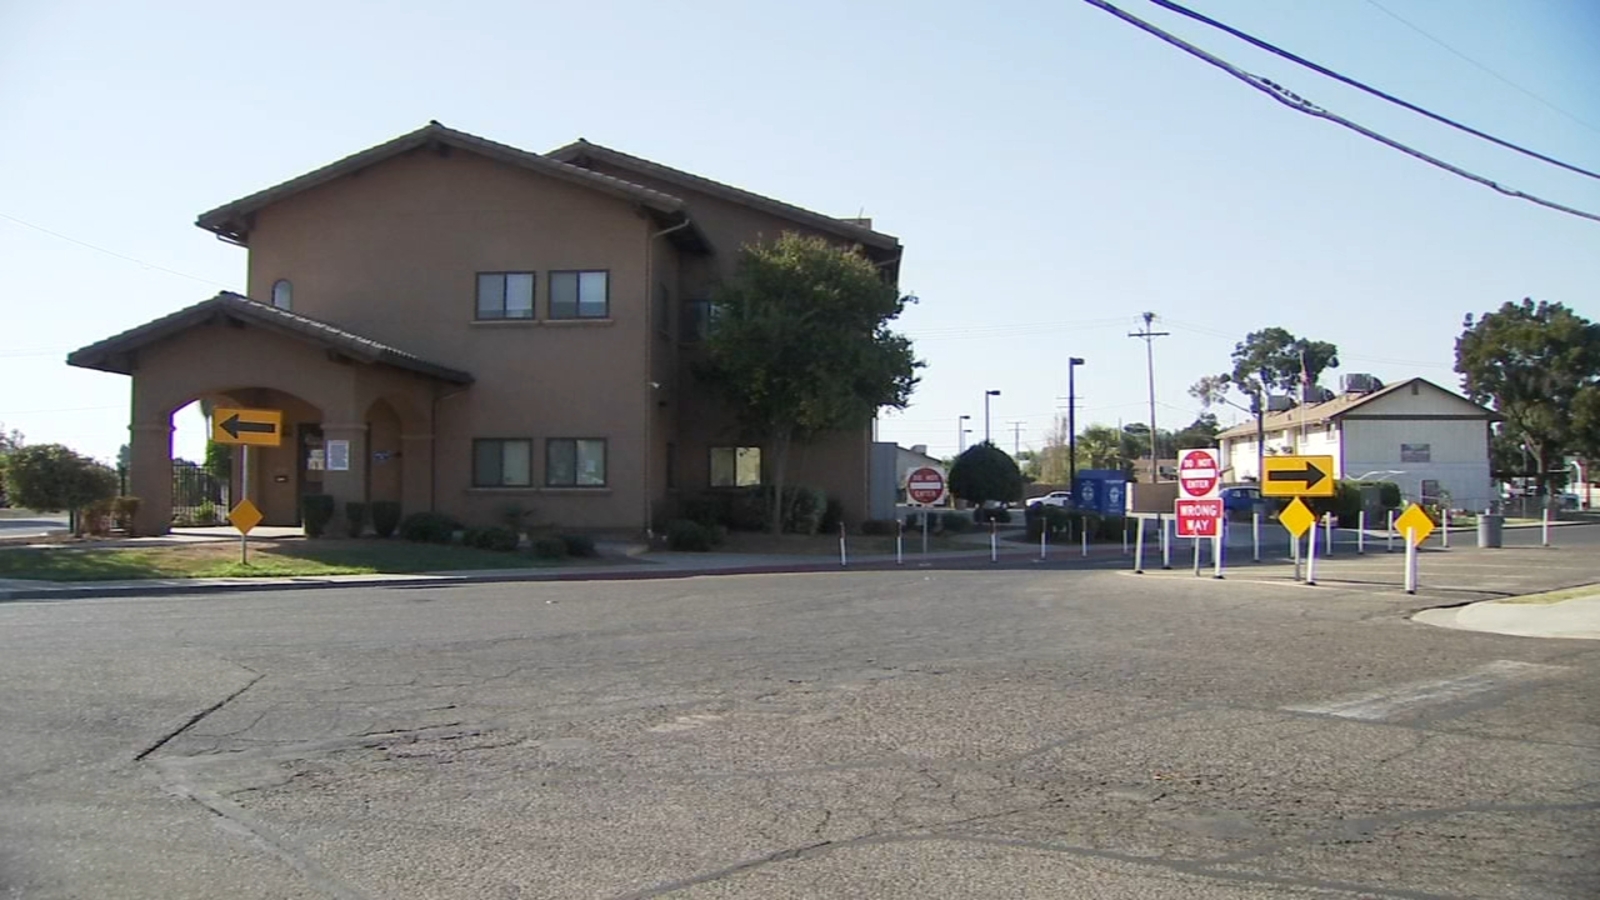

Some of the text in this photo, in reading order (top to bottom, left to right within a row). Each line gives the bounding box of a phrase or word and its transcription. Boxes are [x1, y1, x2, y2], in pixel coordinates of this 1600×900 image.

[1184, 459, 1213, 468] DO NOT
[1185, 480, 1210, 489] ENTER
[1179, 505, 1218, 517] WRONG
[1185, 519, 1209, 531] WAY
